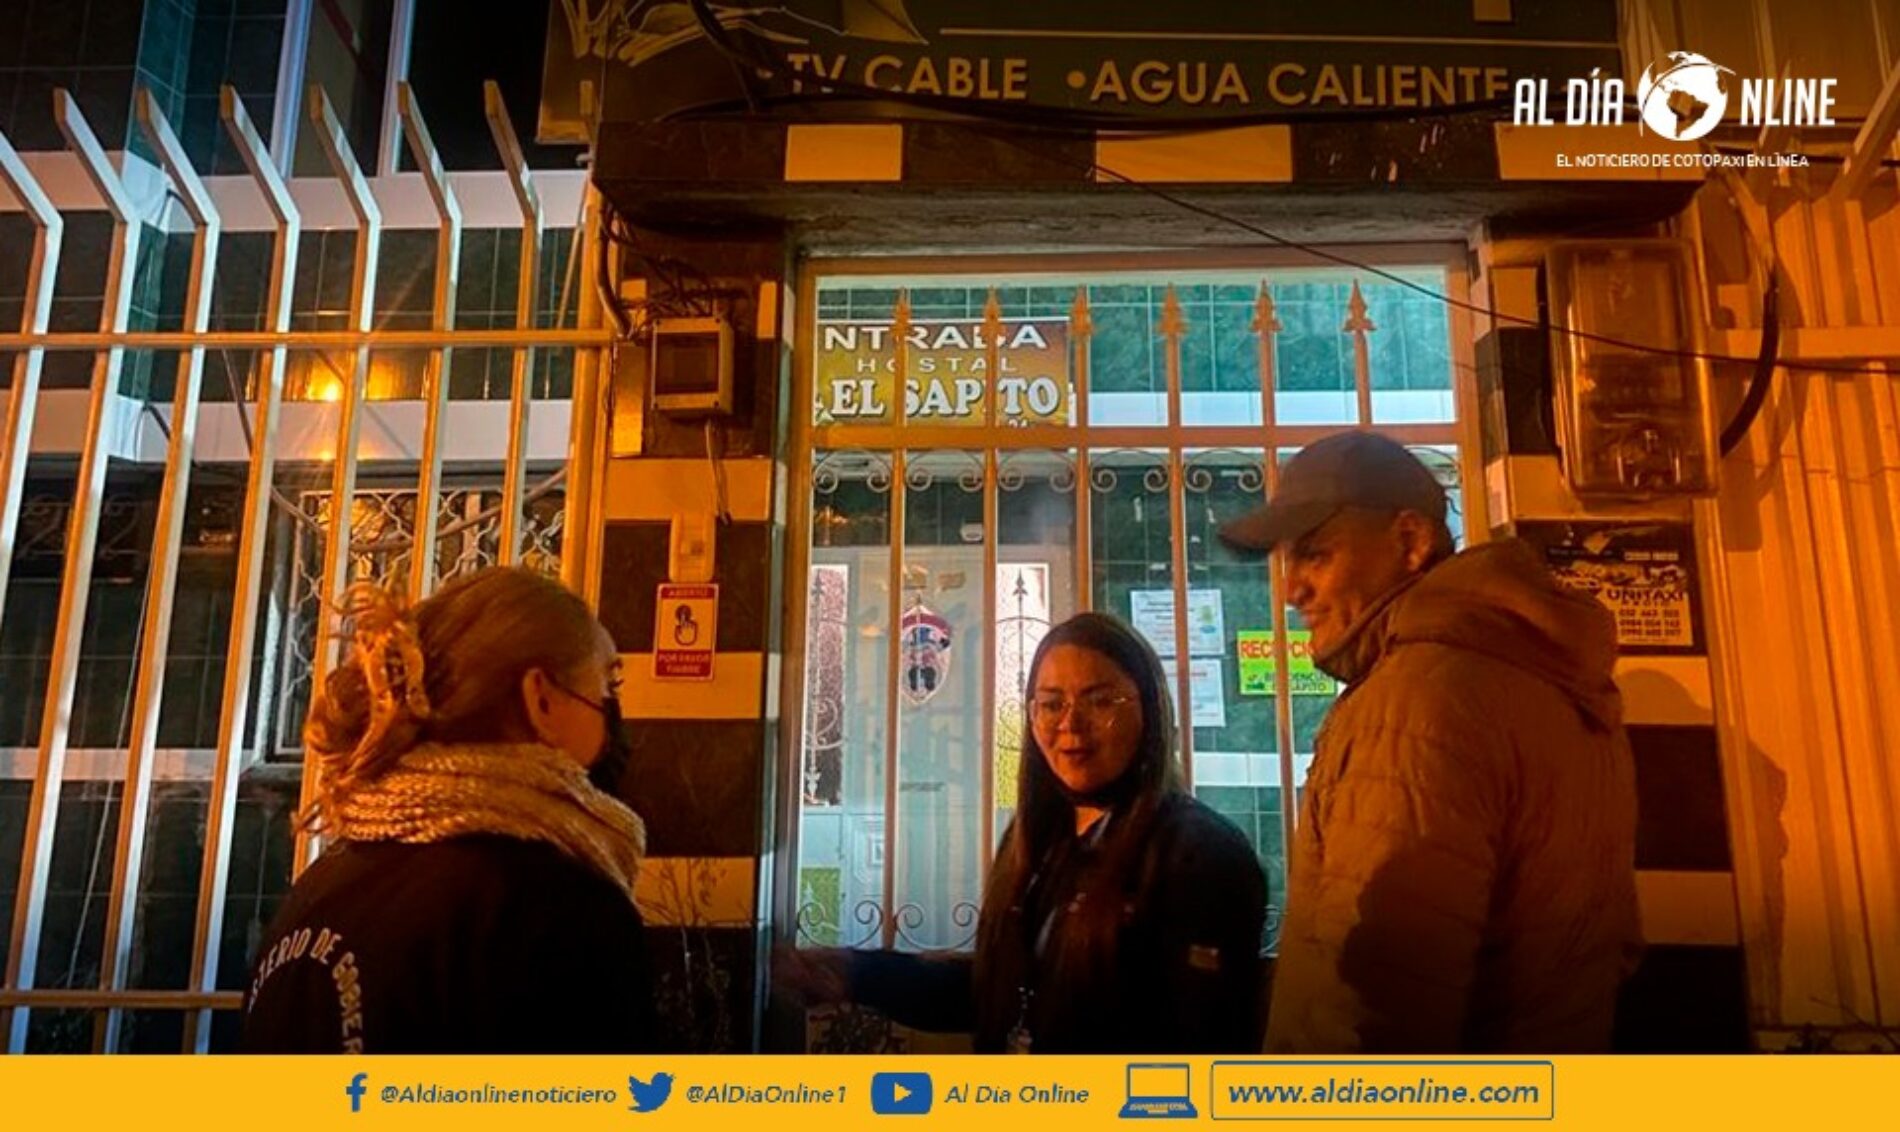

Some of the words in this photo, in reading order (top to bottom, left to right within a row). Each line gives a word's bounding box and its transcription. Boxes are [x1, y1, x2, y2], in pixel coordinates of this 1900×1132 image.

[786, 53, 847, 94] TV
[864, 54, 1028, 100] CABLE
[1090, 60, 1249, 103] AGUA
[1267, 62, 1509, 108] CALIENTE
[830, 377, 887, 417] EL
[904, 376, 1060, 417] SAPTO
[310, 927, 343, 965] DE
